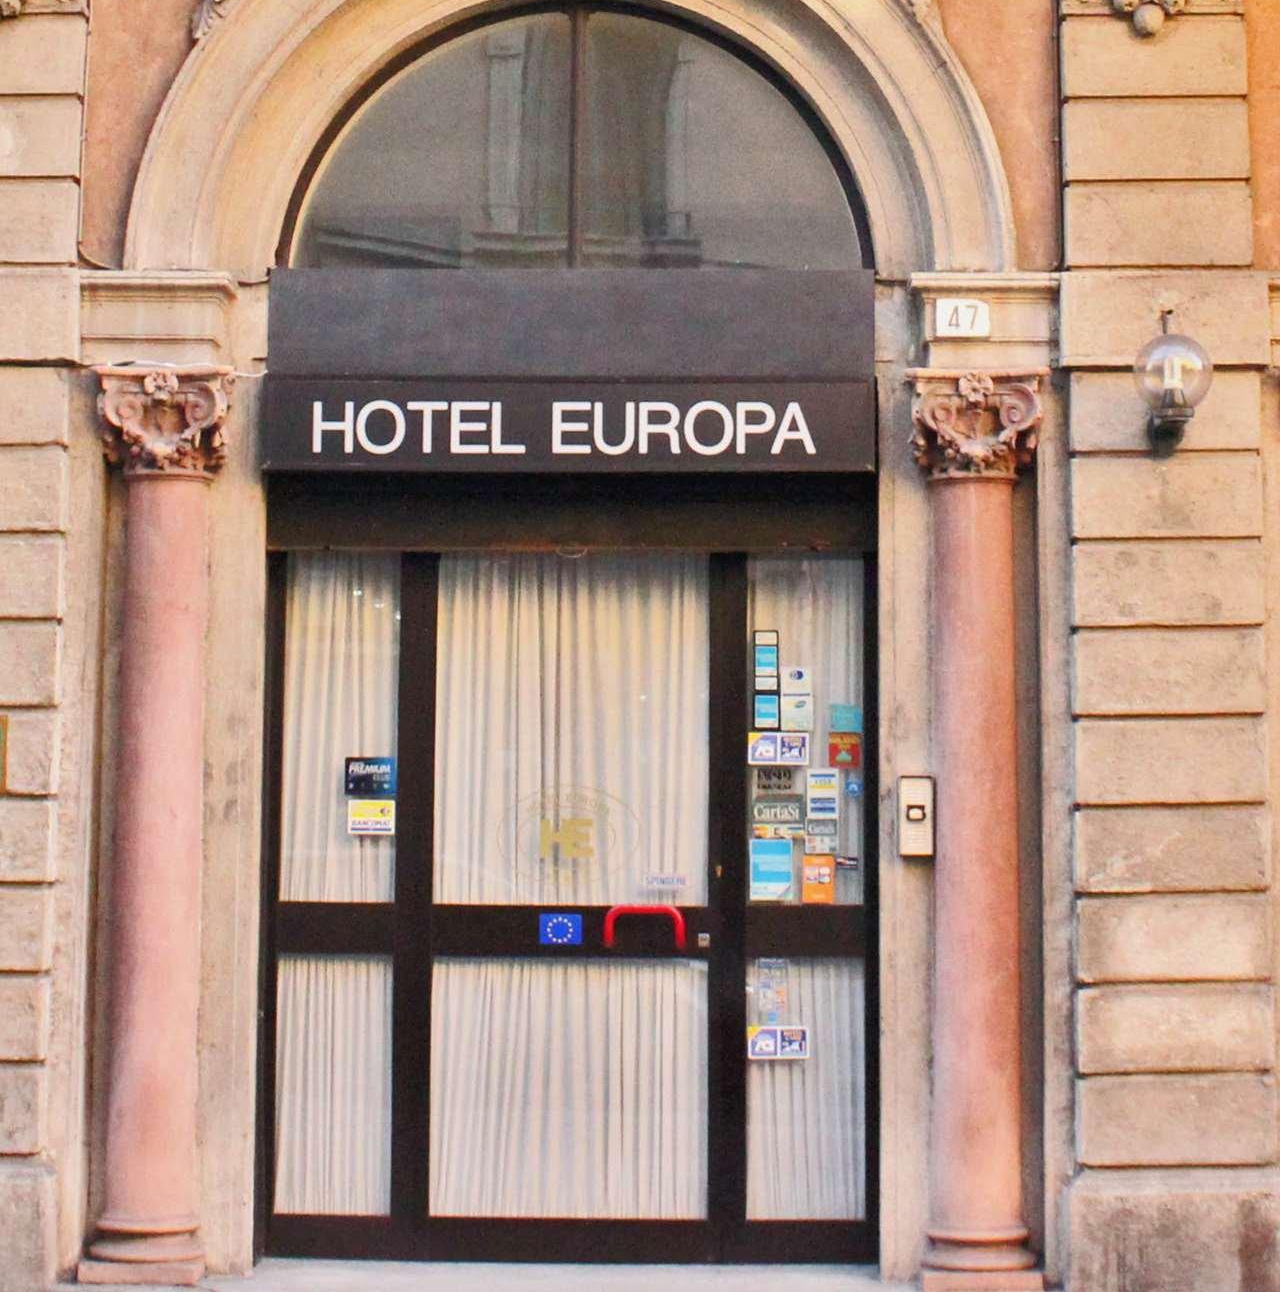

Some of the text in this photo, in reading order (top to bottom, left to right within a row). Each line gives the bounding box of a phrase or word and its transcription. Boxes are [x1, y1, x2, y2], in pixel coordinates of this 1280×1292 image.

[948, 304, 978, 330] 47
[312, 399, 817, 456] HOTEL EUROPA
